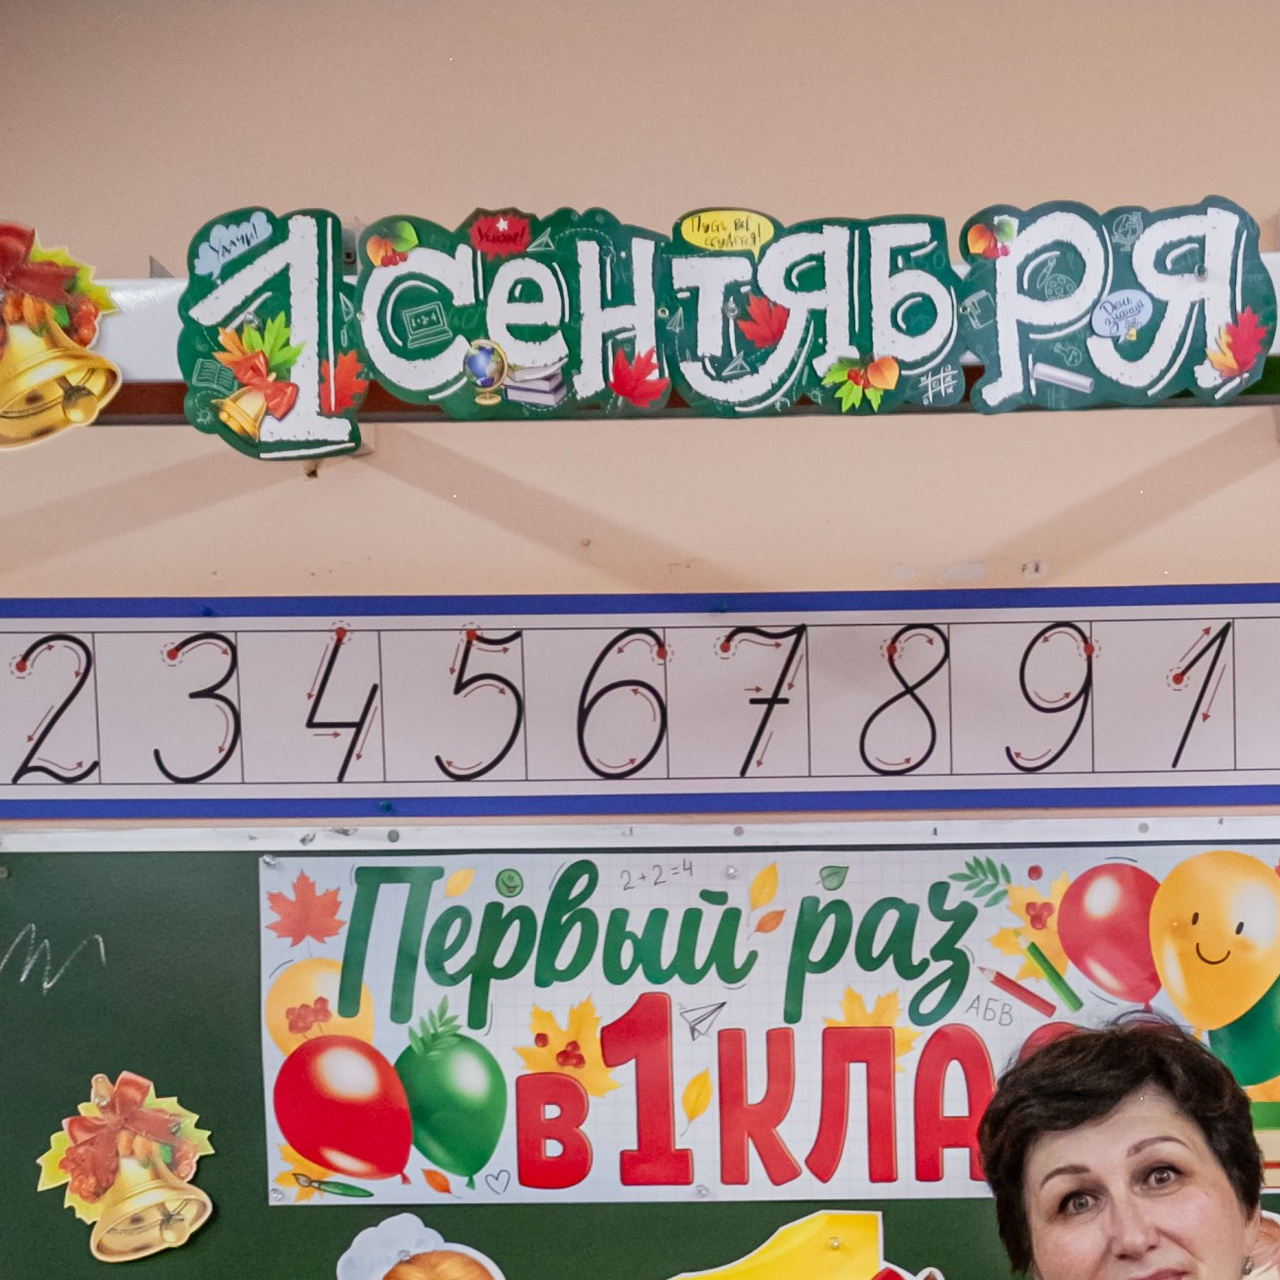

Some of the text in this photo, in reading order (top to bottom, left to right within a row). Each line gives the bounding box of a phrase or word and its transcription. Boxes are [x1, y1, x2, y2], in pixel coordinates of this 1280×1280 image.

[187, 214, 352, 442] 1
[12, 632, 100, 784] 2
[153, 631, 241, 784] 3
[304, 628, 380, 783] 4
[434, 628, 524, 780] 5
[576, 626, 668, 778] 6
[722, 622, 808, 777] 7
[859, 622, 950, 776] 8
[1005, 620, 1094, 773] 9
[337, 858, 978, 1031] Первый раз
[965, 993, 1015, 1028] АБВ
[600, 991, 694, 1188] 1
